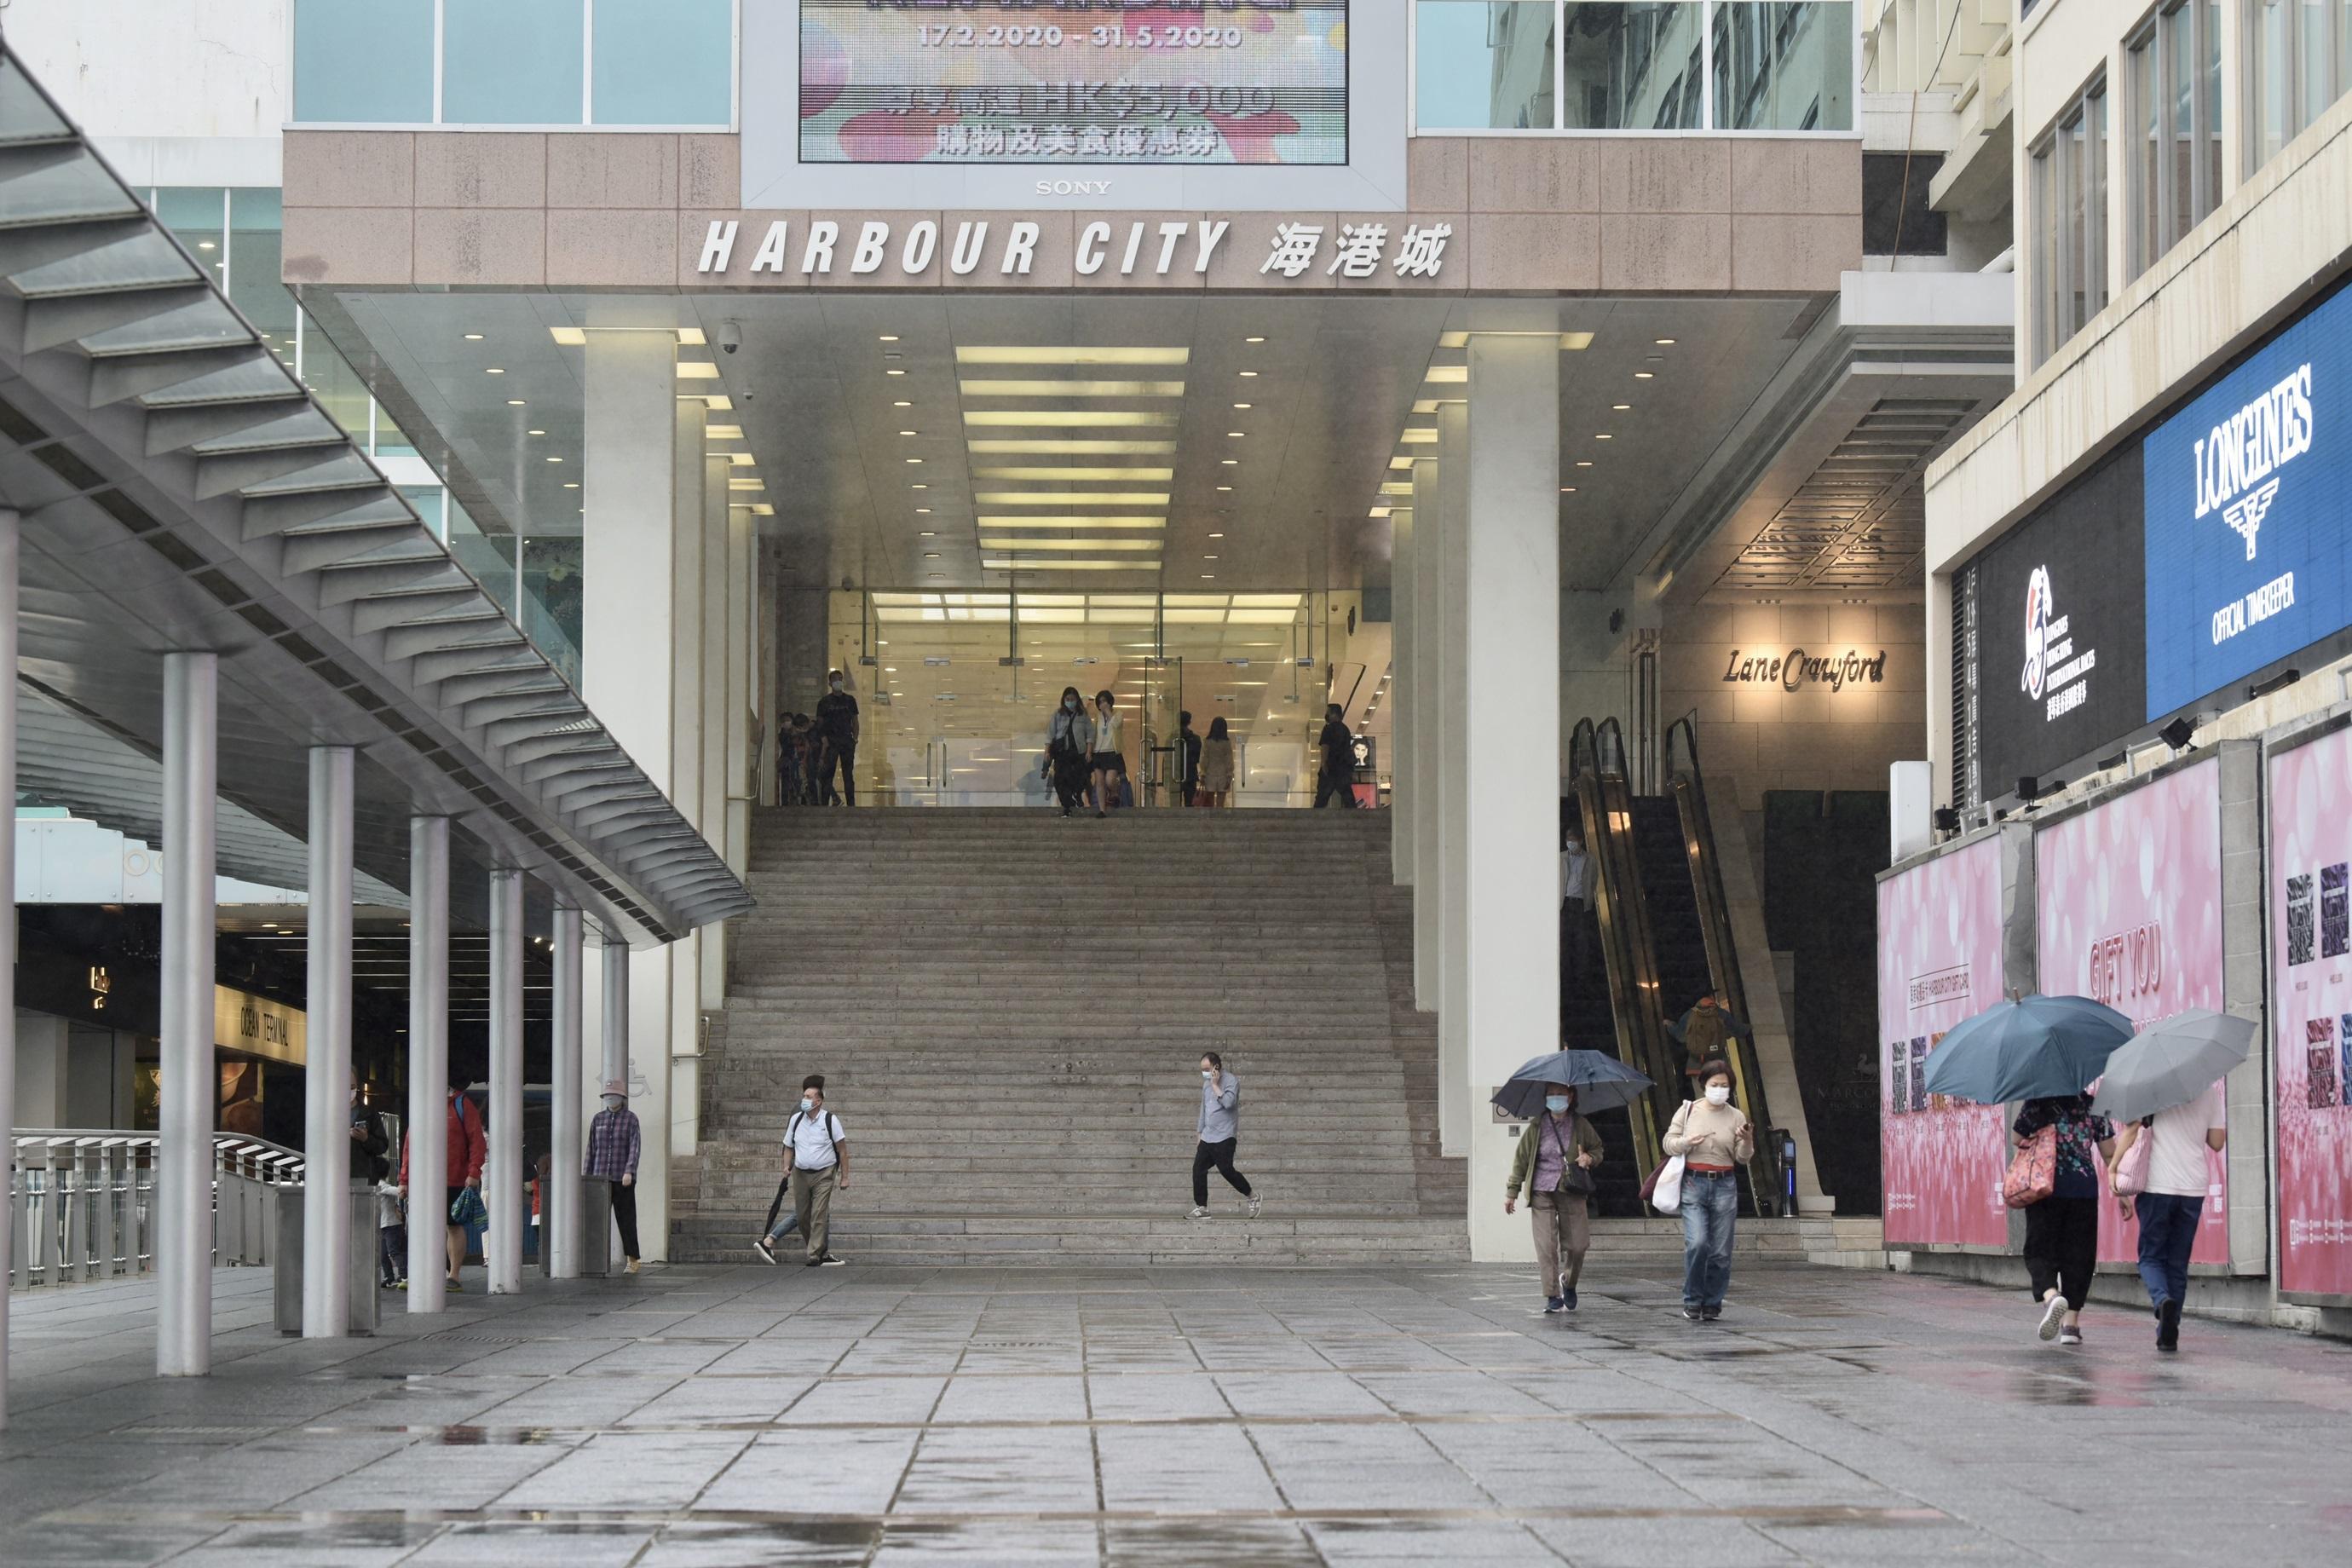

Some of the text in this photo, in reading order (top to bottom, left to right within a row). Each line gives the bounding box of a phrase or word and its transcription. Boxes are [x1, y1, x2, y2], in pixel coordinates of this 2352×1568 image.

[918, 26, 1064, 46] 17.2.2020
[1091, 26, 1242, 48] 31.5.2020
[1035, 78, 1276, 121] HK$5,000
[937, 124, 1220, 157] 購物及美食優惠券
[1035, 181, 1113, 195] SONY
[697, 221, 1453, 278] HARBOUR CITY 海港城
[2194, 362, 2313, 520] LONGINES
[2212, 571, 2295, 645] OFFICIAL TIMEKEEPER
[1723, 648, 1887, 694] Lane Crawford
[2090, 920, 2161, 1005] GIFT YOU
[240, 1006, 288, 1046] OCEAN TERMINAL
